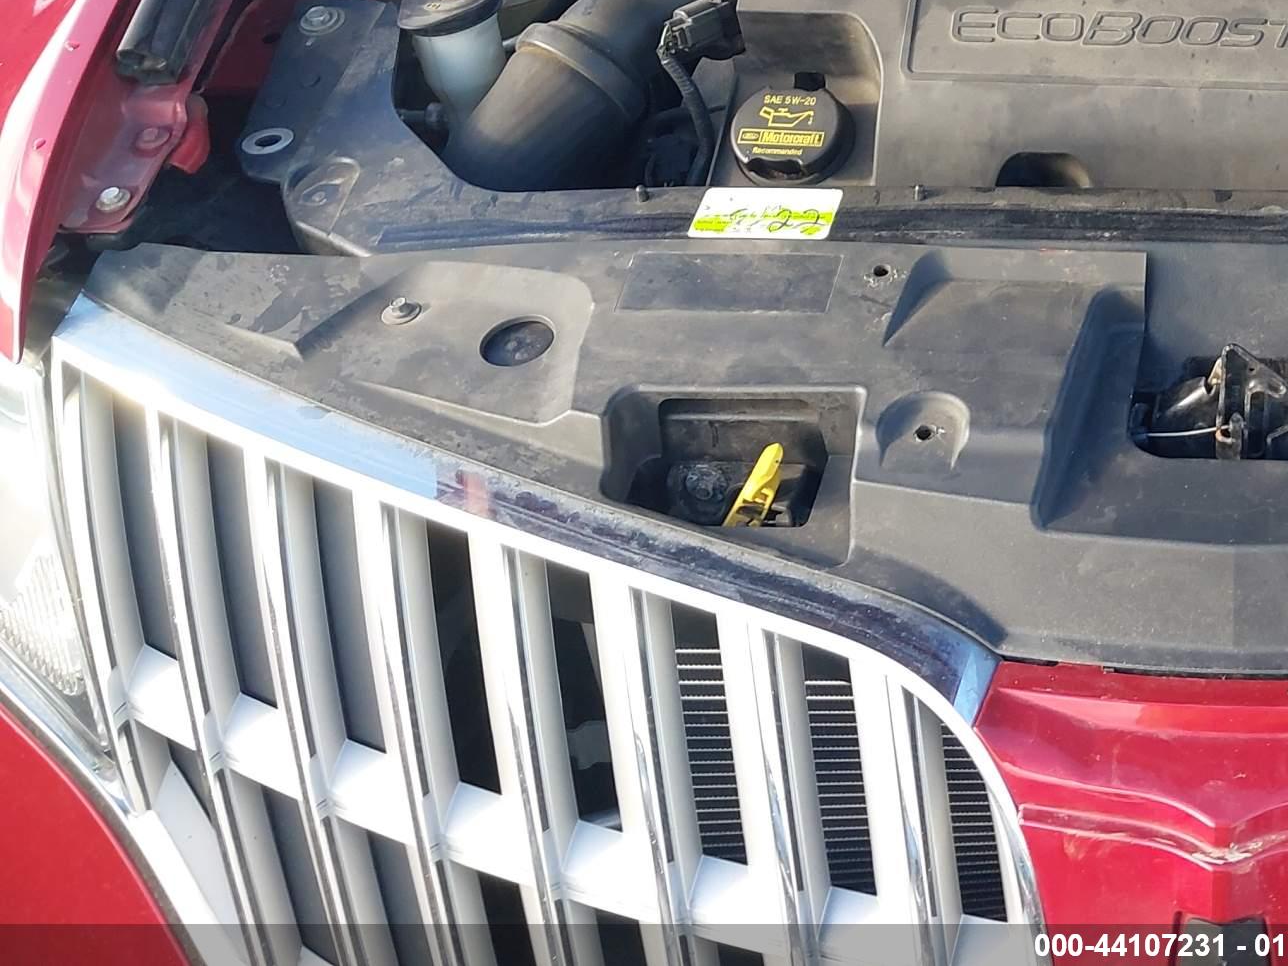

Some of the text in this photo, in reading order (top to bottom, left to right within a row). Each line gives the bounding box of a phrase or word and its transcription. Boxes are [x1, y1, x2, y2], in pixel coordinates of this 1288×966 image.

[764, 94, 817, 106] SAE 5W-20
[762, 131, 820, 145] Motorcraft
[751, 146, 804, 156] Recommended
